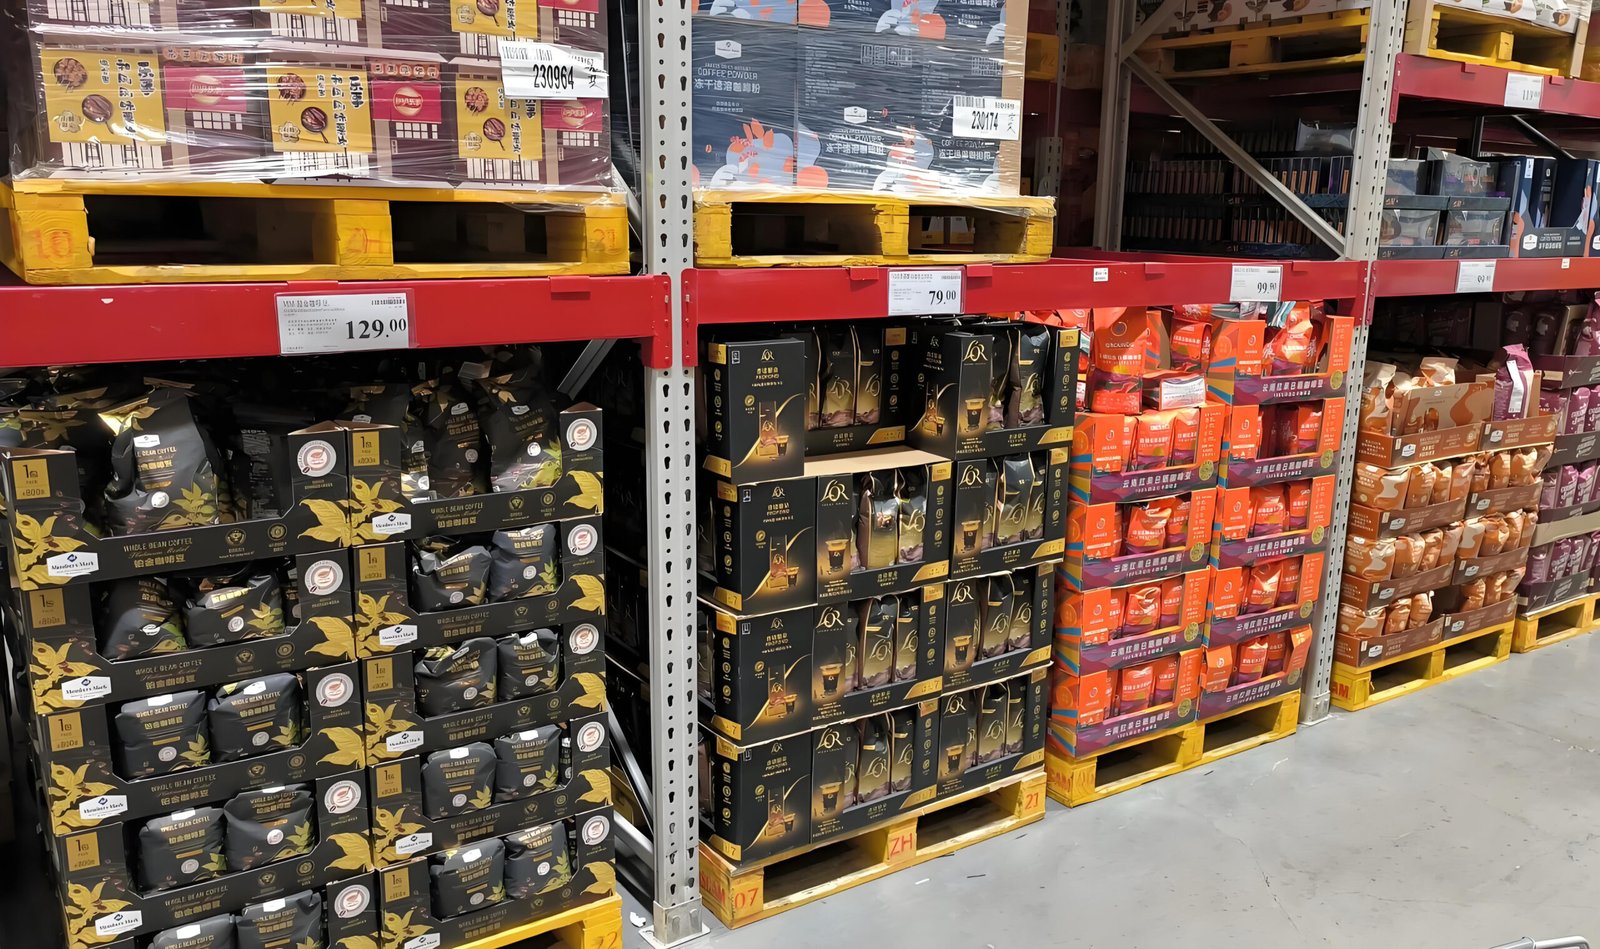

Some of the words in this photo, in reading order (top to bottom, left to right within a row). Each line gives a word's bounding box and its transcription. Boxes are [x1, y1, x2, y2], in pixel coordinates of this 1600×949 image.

[533, 64, 574, 89] 230964
[971, 110, 999, 131] 230174
[929, 290, 956, 305] 79.00
[346, 318, 407, 340] 129.00
[963, 340, 988, 361] L'OR
[959, 464, 983, 487] L'OR
[820, 480, 850, 502] L'OR
[123, 543, 149, 553] WHOLE
[150, 541, 167, 550] BEAN
[951, 582, 974, 603] L'OR
[815, 606, 844, 629] L'OR
[944, 695, 967, 715] L'OR
[816, 728, 843, 749] L'OR
[889, 832, 912, 857] ZH
[735, 888, 758, 909] 07
